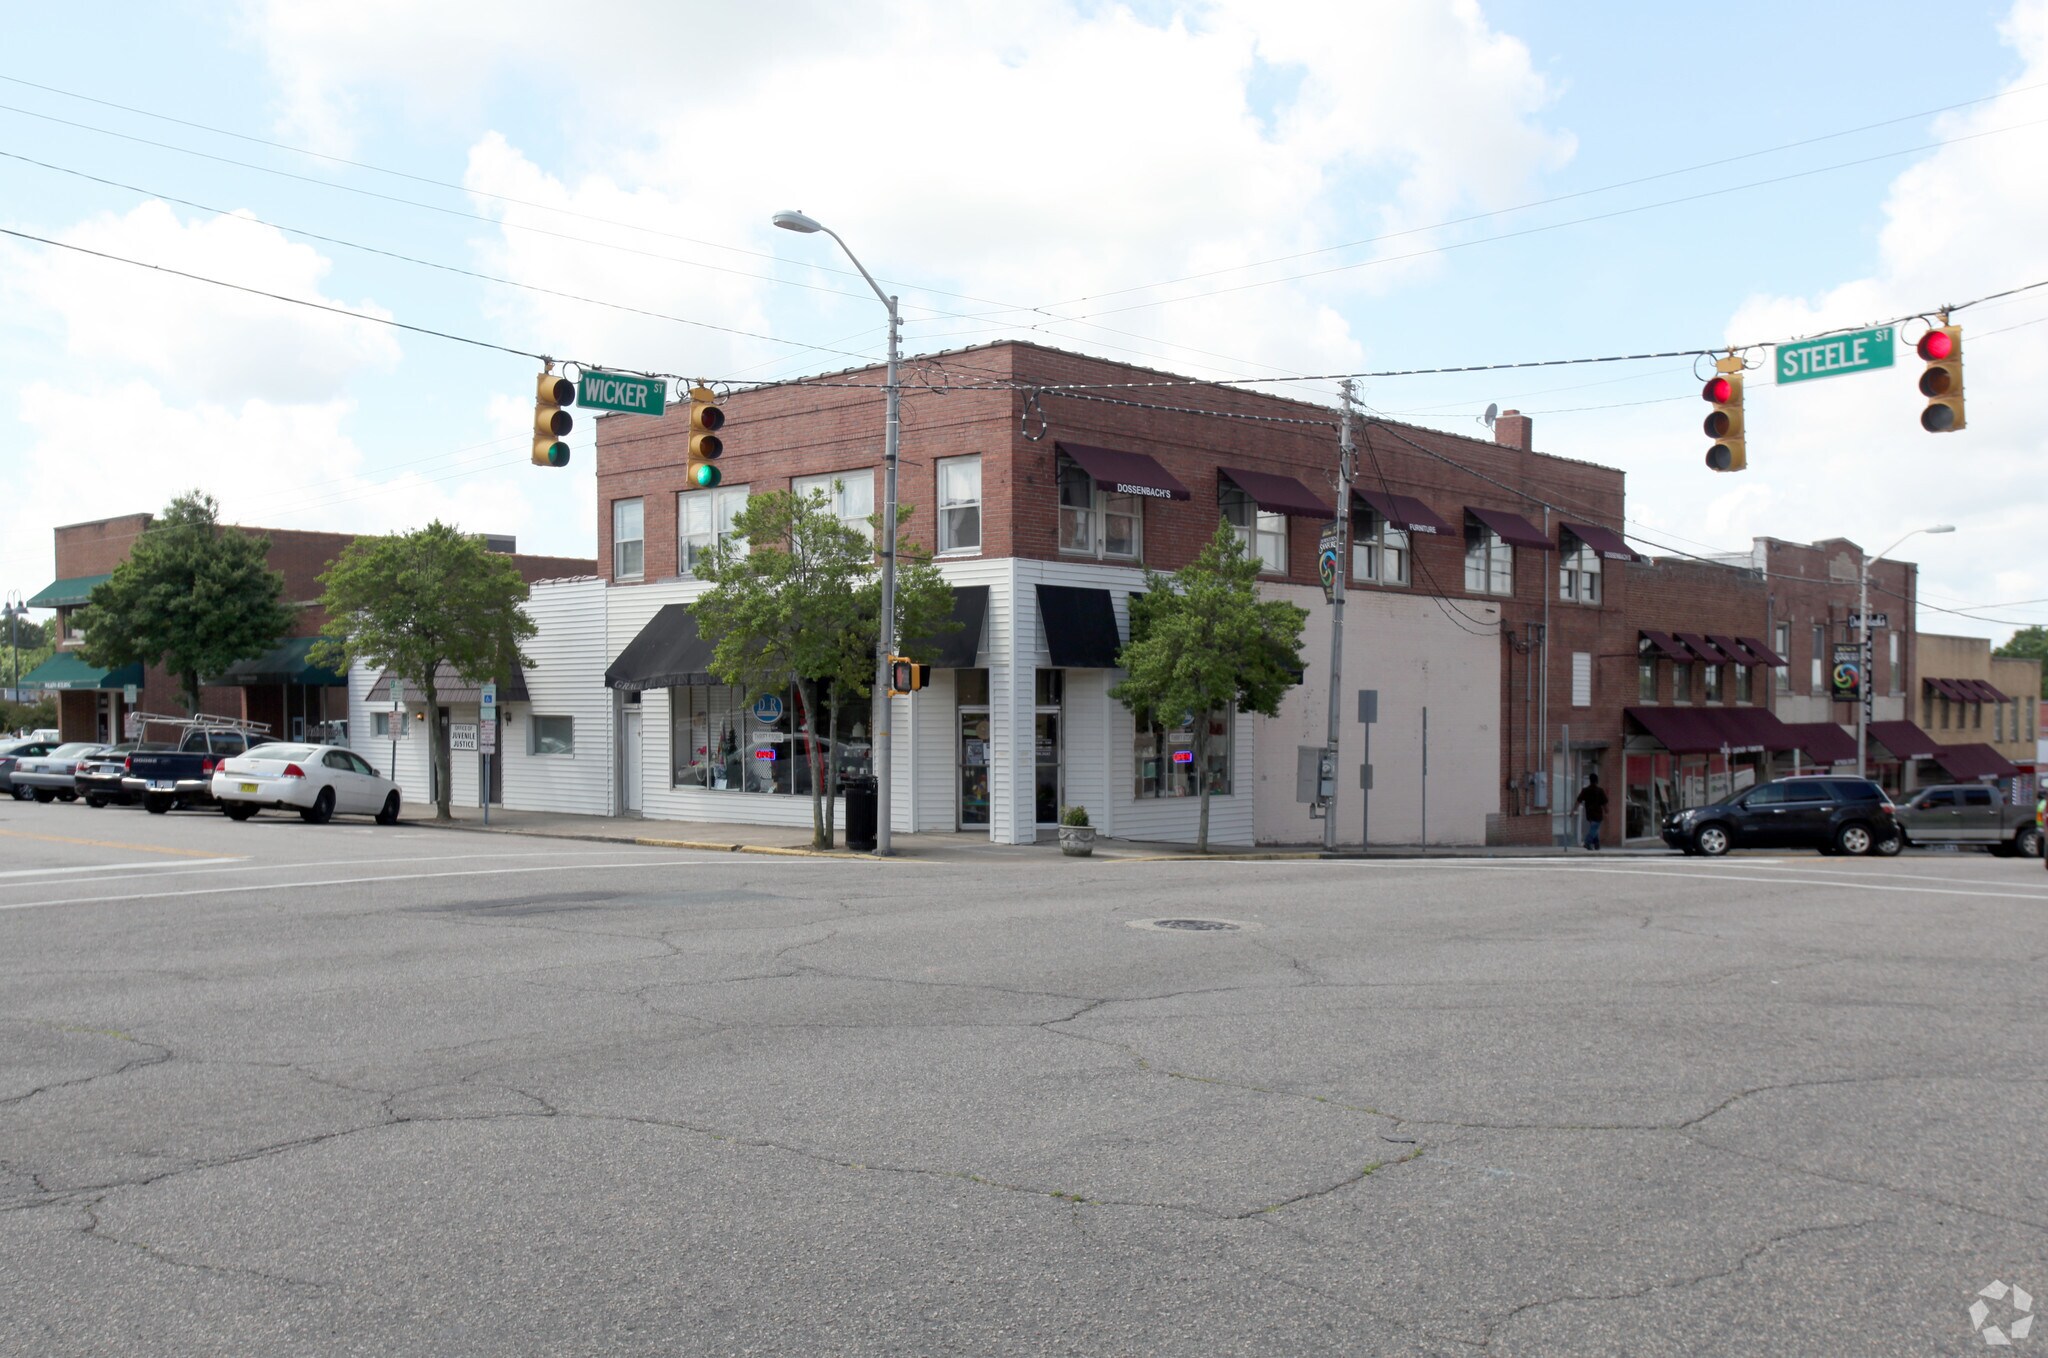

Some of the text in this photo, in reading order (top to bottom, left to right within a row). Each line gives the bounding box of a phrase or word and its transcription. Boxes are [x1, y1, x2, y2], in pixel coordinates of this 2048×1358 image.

[1783, 329, 1889, 376] STEELE ST
[585, 377, 664, 408] WICKER ST
[1117, 483, 1171, 499] DOSSENBACH'S
[1409, 523, 1437, 534] FURNITURE
[452, 732, 475, 740] JUVENILE
[453, 740, 474, 748] JUSTICE
